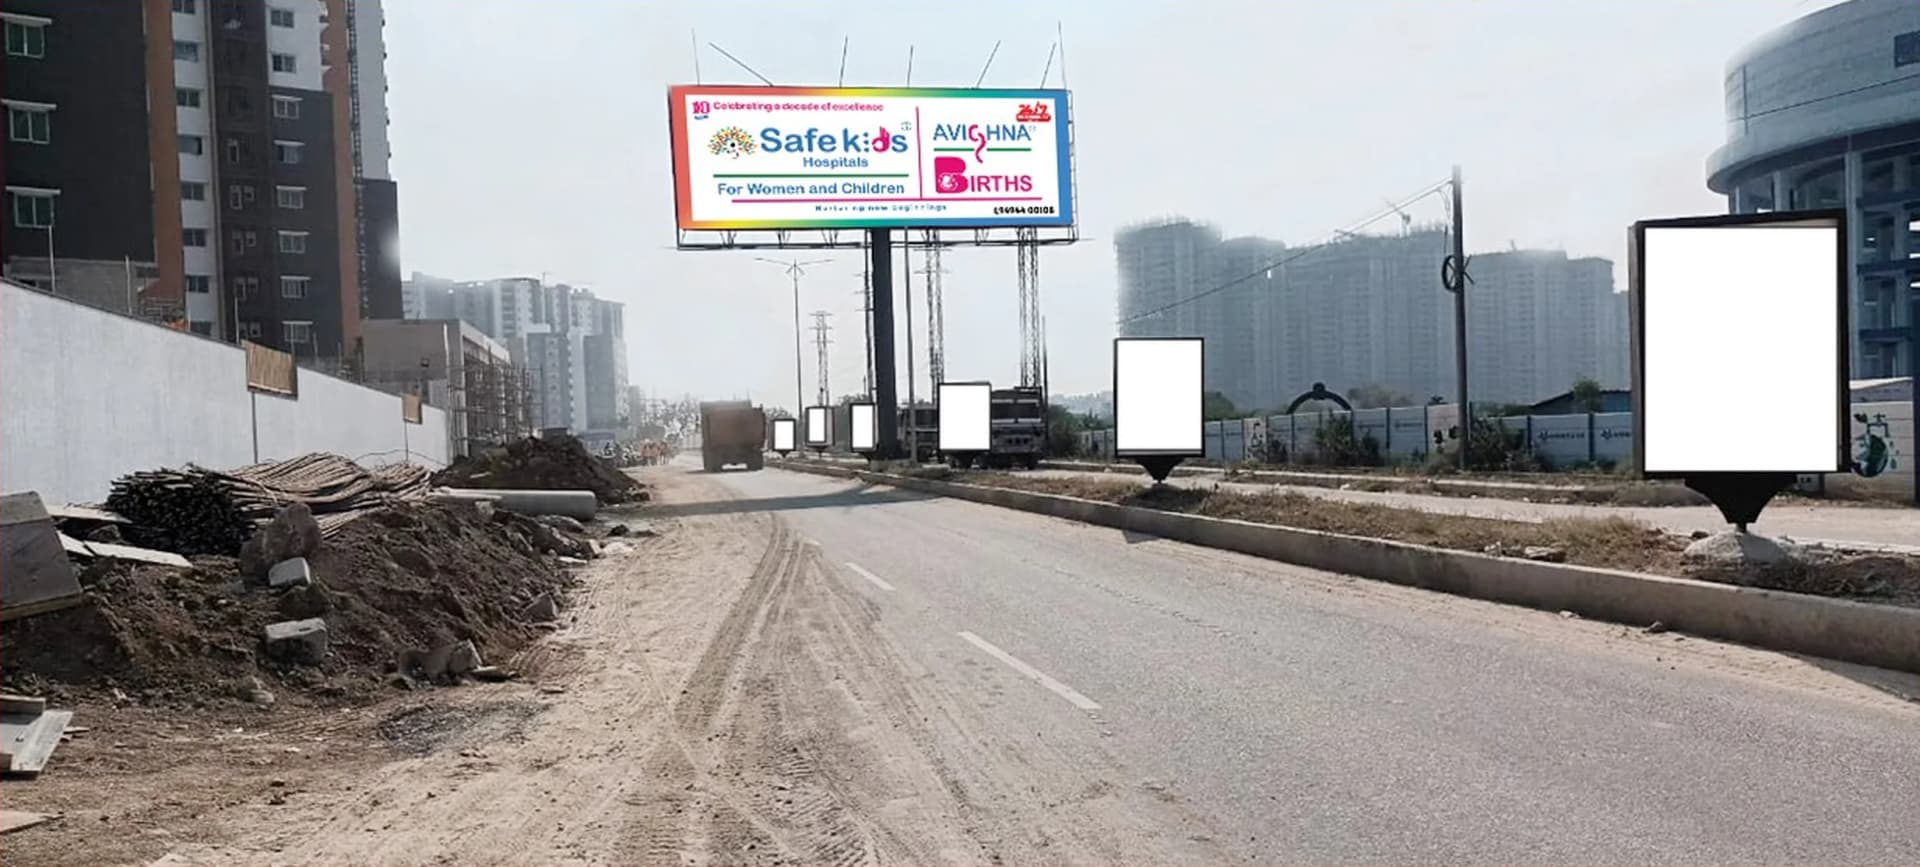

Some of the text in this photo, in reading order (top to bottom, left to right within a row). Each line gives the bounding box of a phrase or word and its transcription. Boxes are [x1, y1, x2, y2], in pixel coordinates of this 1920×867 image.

[713, 101, 884, 113] Celebrating a decade of excellence
[760, 127, 837, 153] Safe
[933, 124, 1031, 155] AVIGHNA
[803, 156, 869, 169] Hospitals
[934, 157, 1033, 194] BIRTHS
[717, 182, 905, 195] For Women and Children
